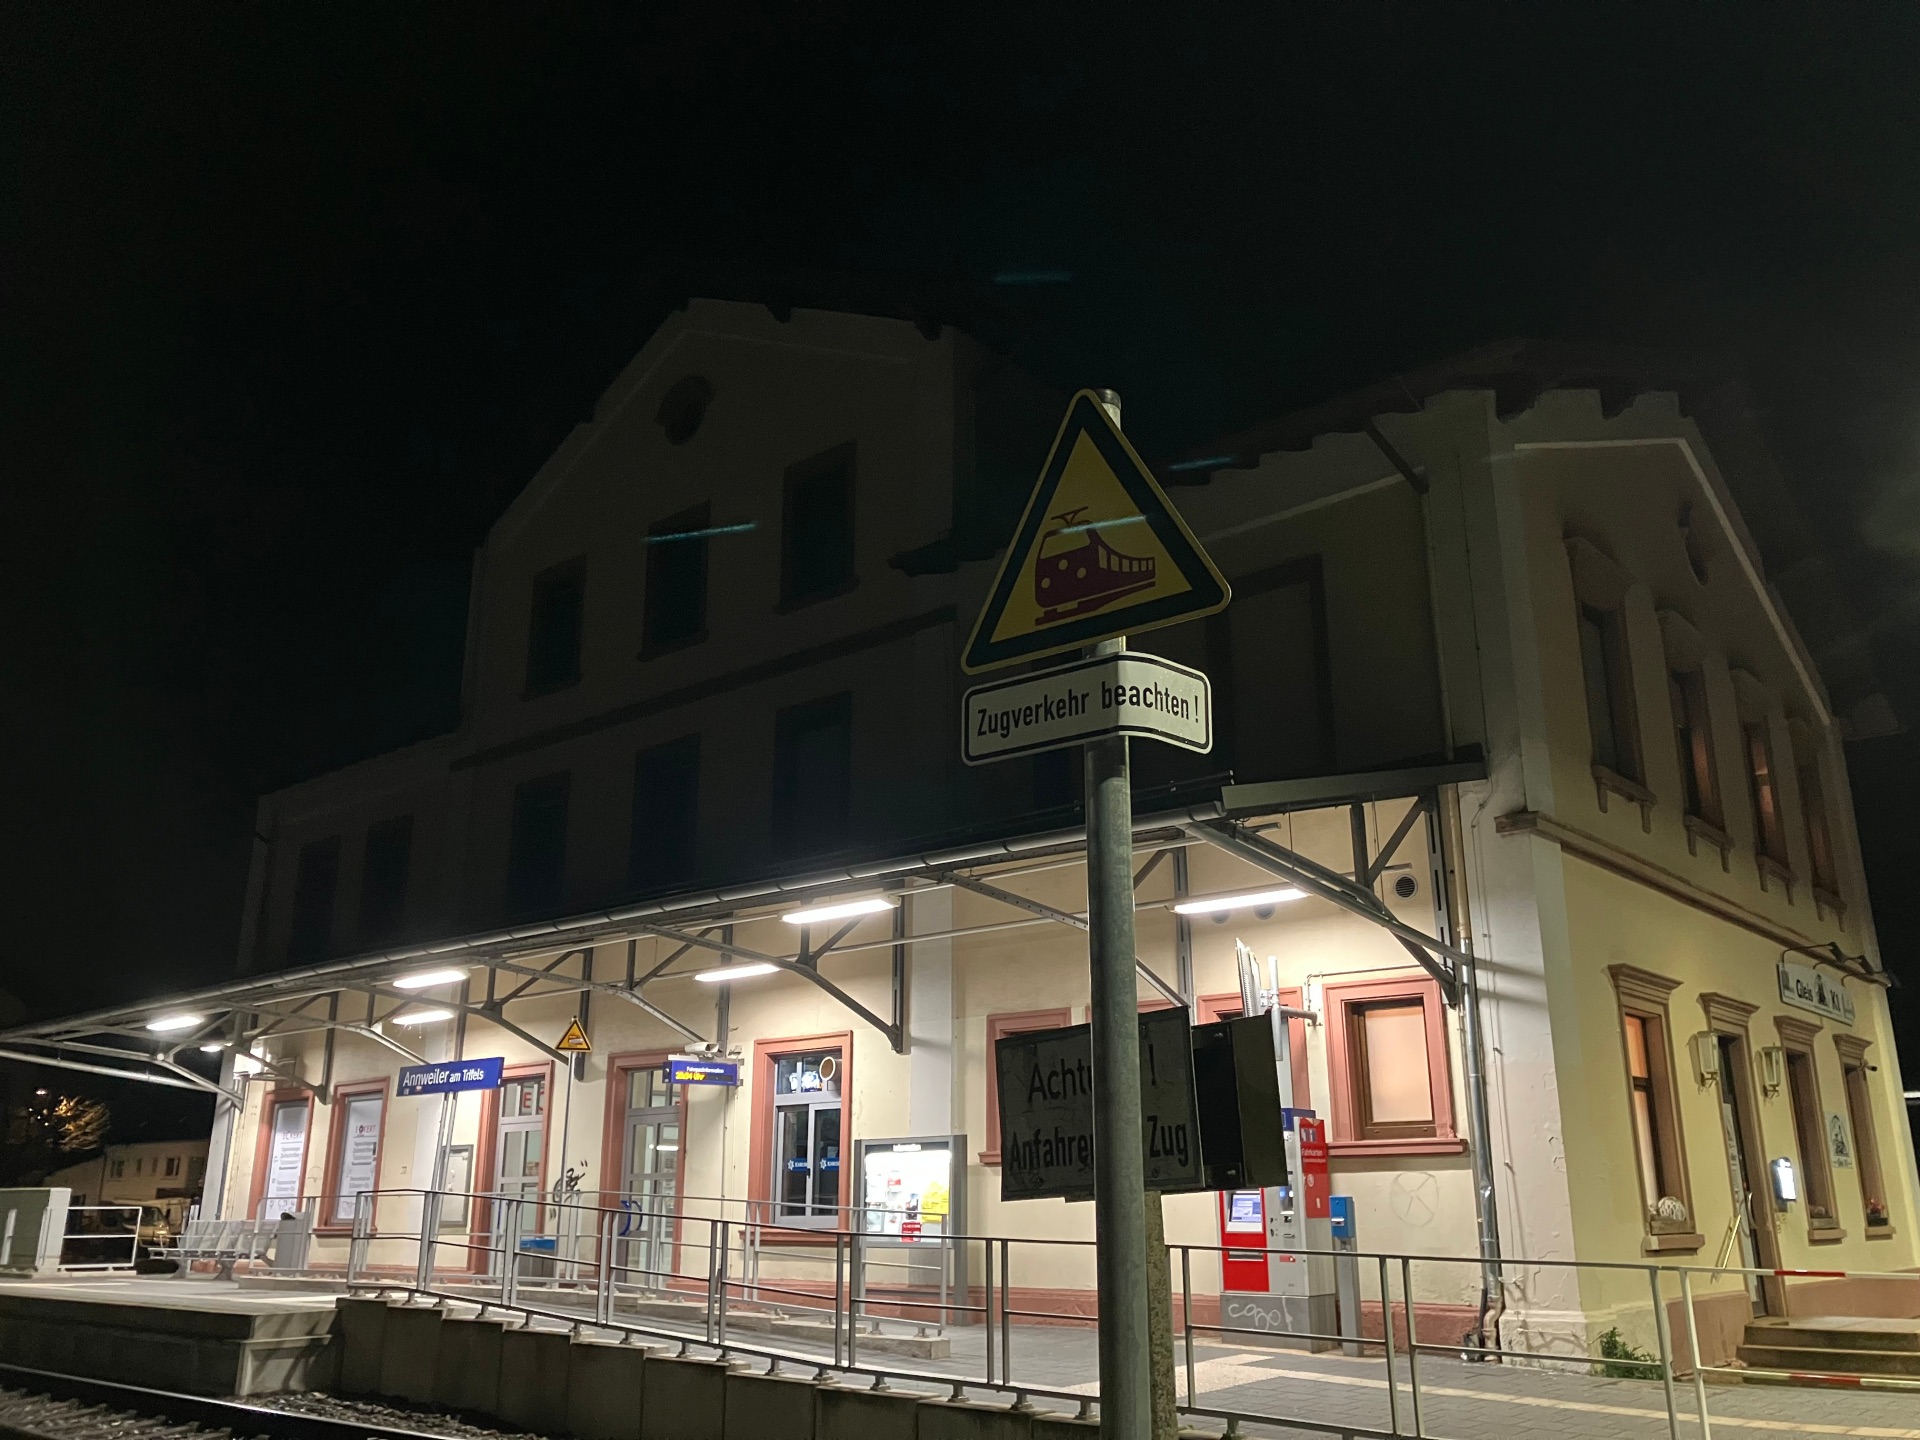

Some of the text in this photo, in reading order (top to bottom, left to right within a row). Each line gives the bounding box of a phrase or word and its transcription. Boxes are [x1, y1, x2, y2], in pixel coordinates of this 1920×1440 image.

[977, 688, 1090, 738] Zugverkehr
[403, 1068, 484, 1087] Annweiler am Trifels
[1147, 1115, 1189, 1167] Zug
